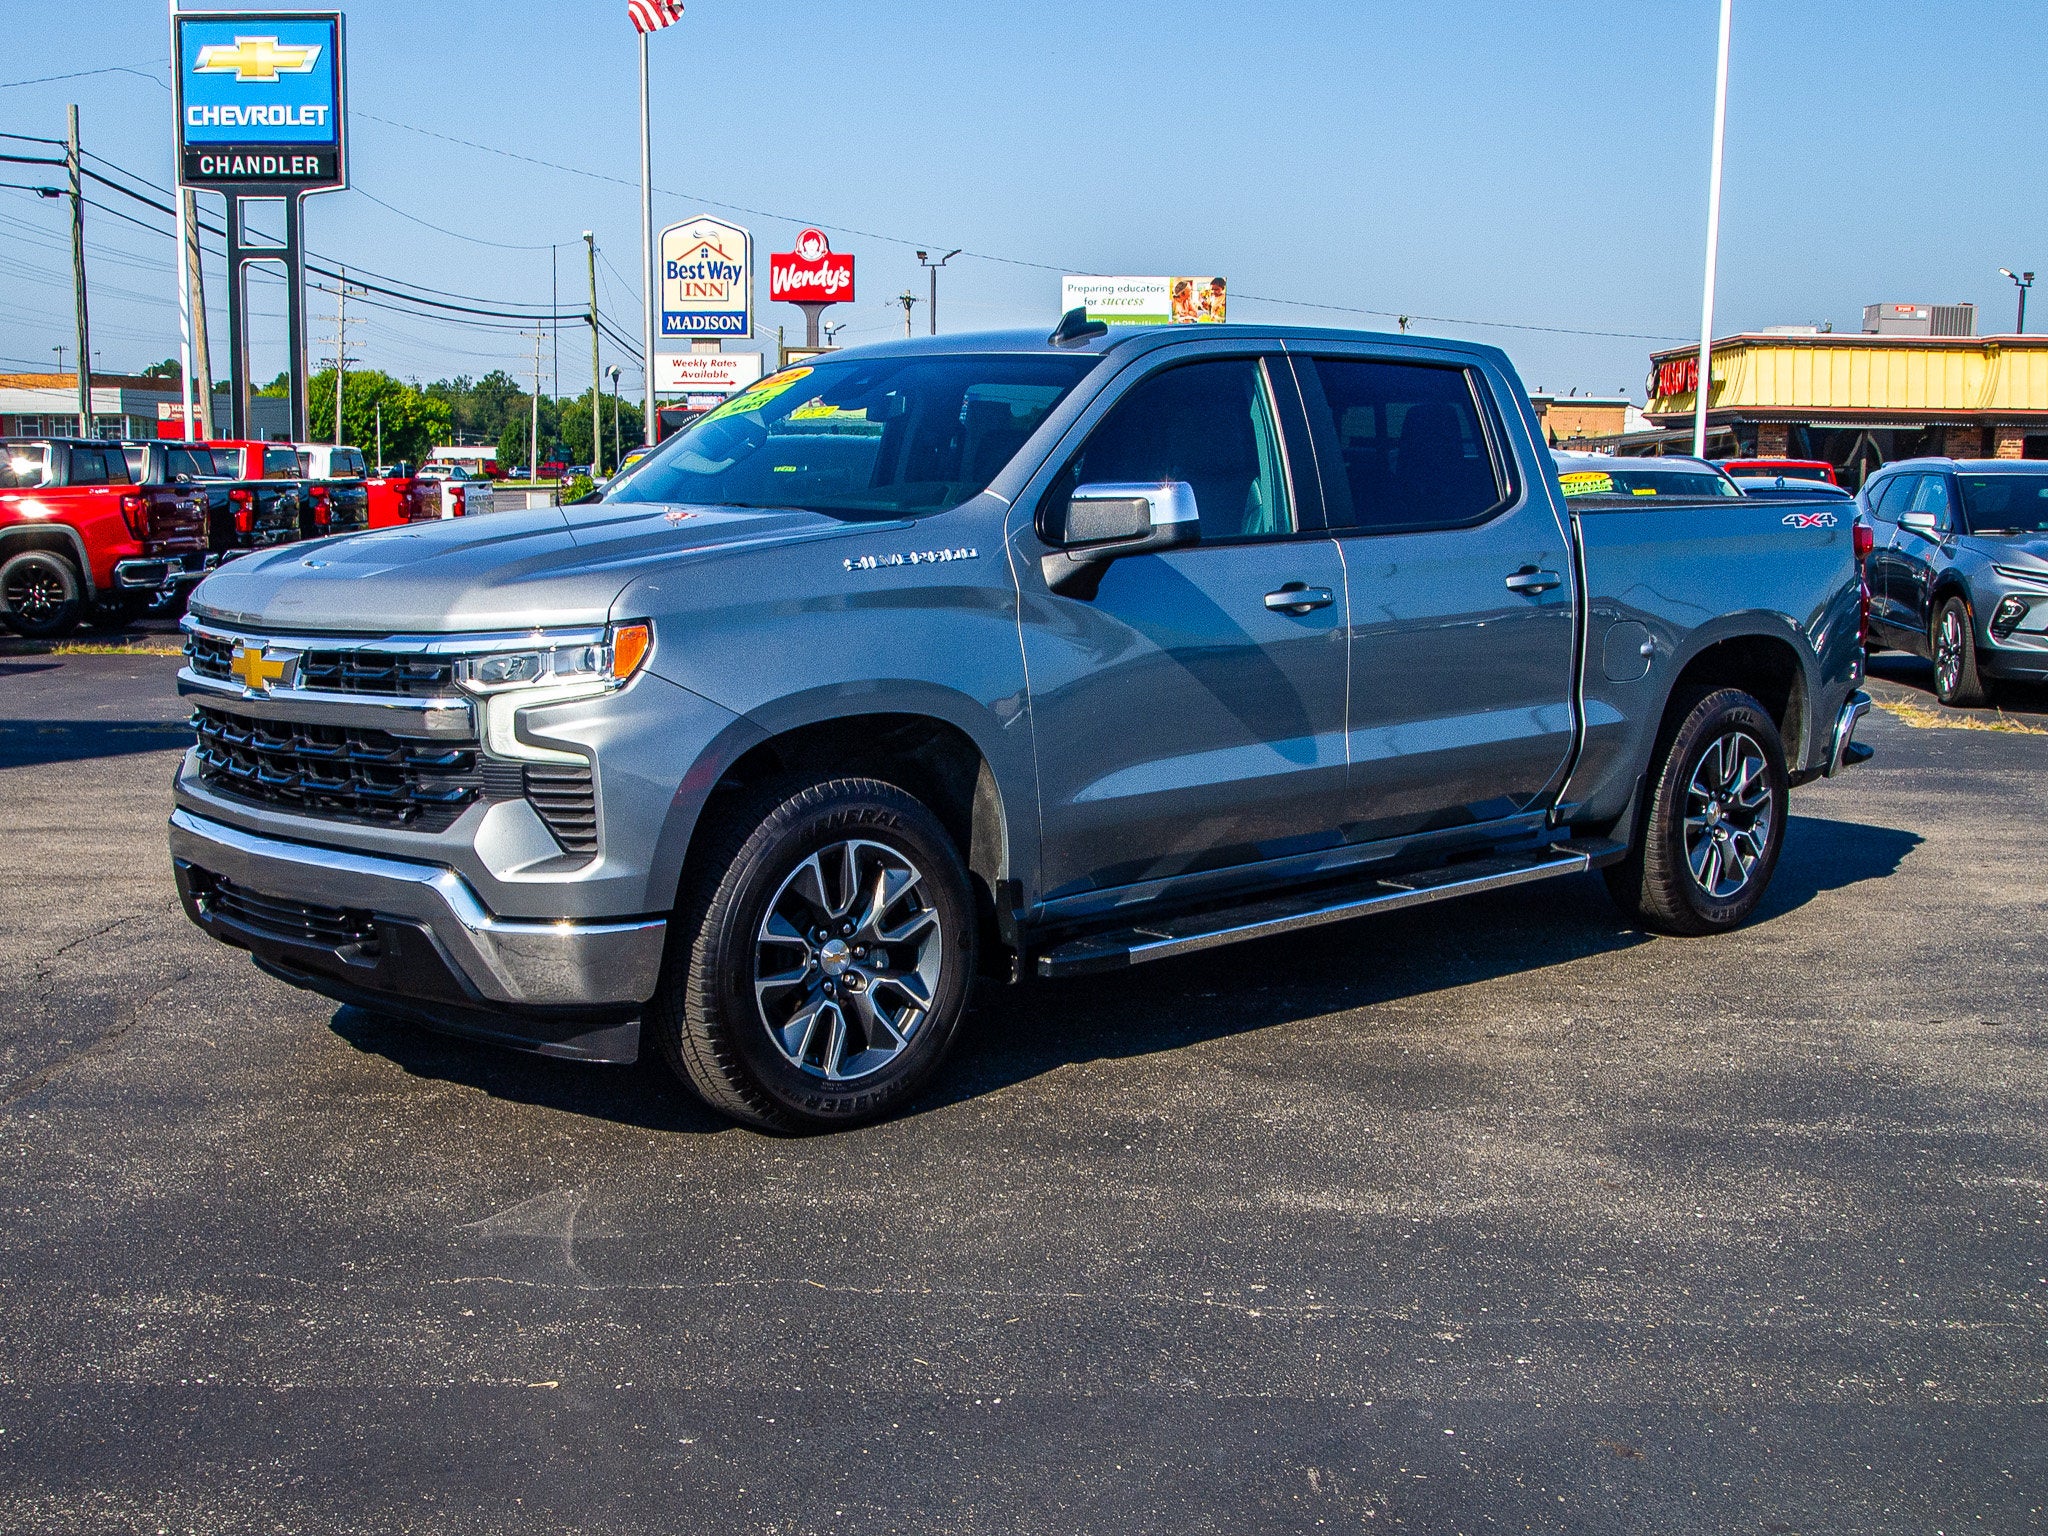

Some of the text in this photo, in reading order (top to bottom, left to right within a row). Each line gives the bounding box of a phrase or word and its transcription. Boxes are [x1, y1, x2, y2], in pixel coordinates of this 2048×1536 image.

[187, 105, 329, 126] CHEVROLET
[200, 156, 320, 175] CHANDLER
[667, 261, 743, 286] Best Way
[772, 260, 850, 295] Wendy's
[685, 283, 724, 297] INN
[1067, 284, 1165, 295] Preparing educators
[1084, 297, 1145, 306] for success
[667, 315, 743, 331] MADISON
[672, 359, 737, 369] Weekly Rates
[681, 370, 729, 378] Available
[1565, 480, 1607, 489] SHARP
[842, 547, 979, 571] SILVERADO
